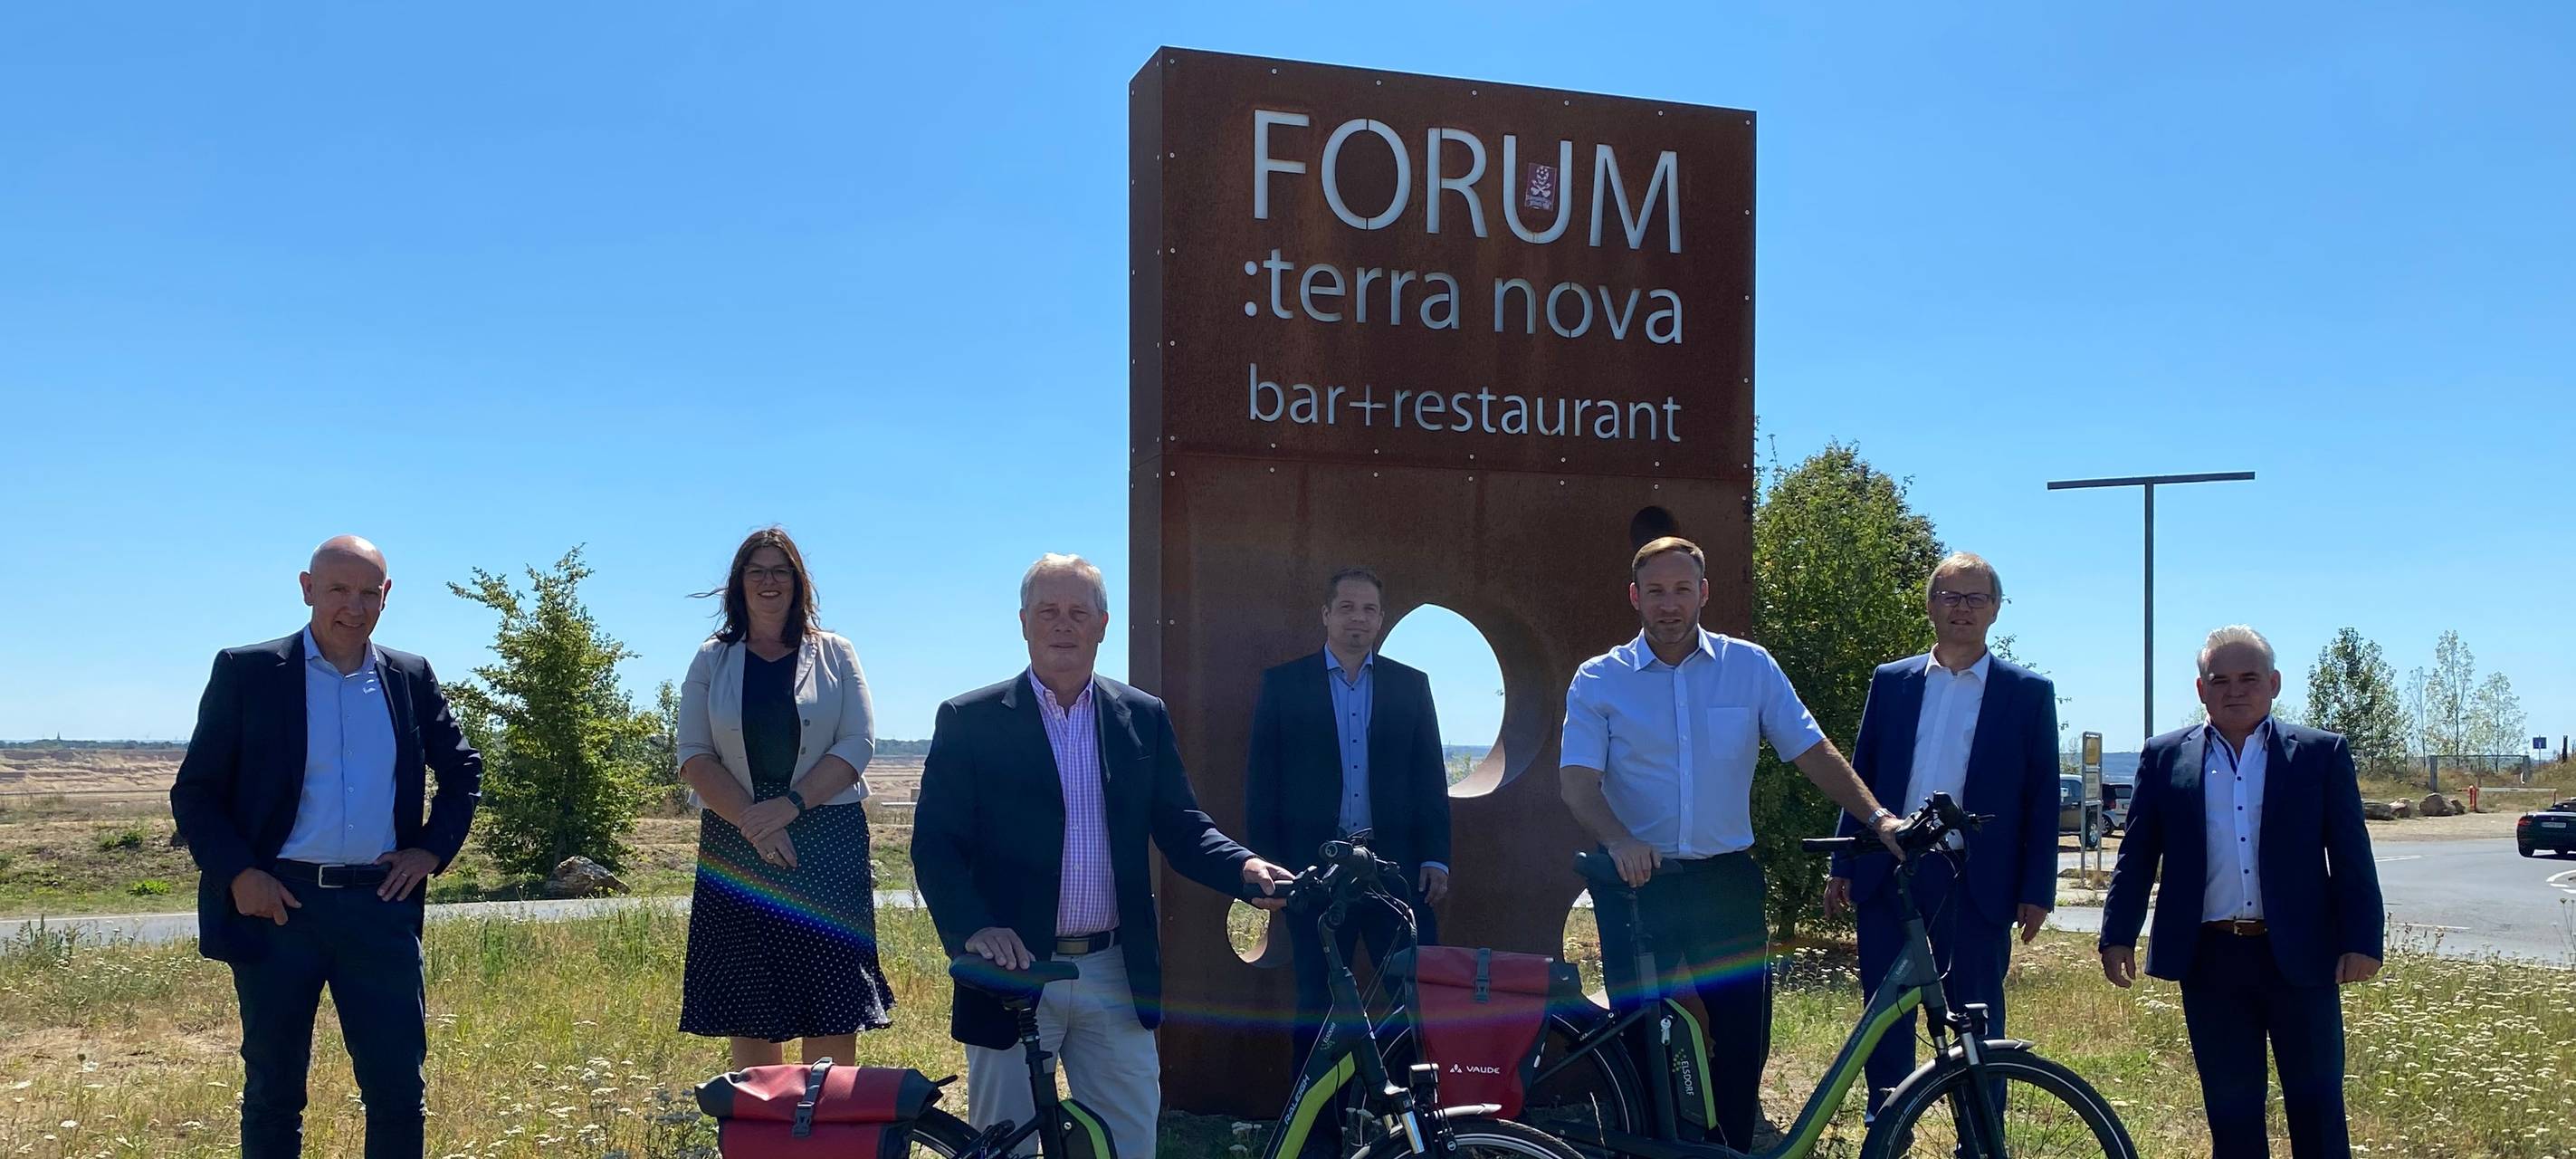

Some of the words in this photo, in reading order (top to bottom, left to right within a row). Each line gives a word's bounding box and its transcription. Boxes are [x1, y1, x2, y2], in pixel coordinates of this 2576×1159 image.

[1254, 109, 1682, 254] FORUM
[1245, 248, 1460, 330] :terra
[1494, 277, 1684, 344] nova
[1249, 363, 1682, 443] bar+restaurant
[1284, 1074, 1310, 1125] RALEIGH
[1466, 1065, 1500, 1074] VAUDE
[1681, 1060, 1694, 1096] ELSDORF
